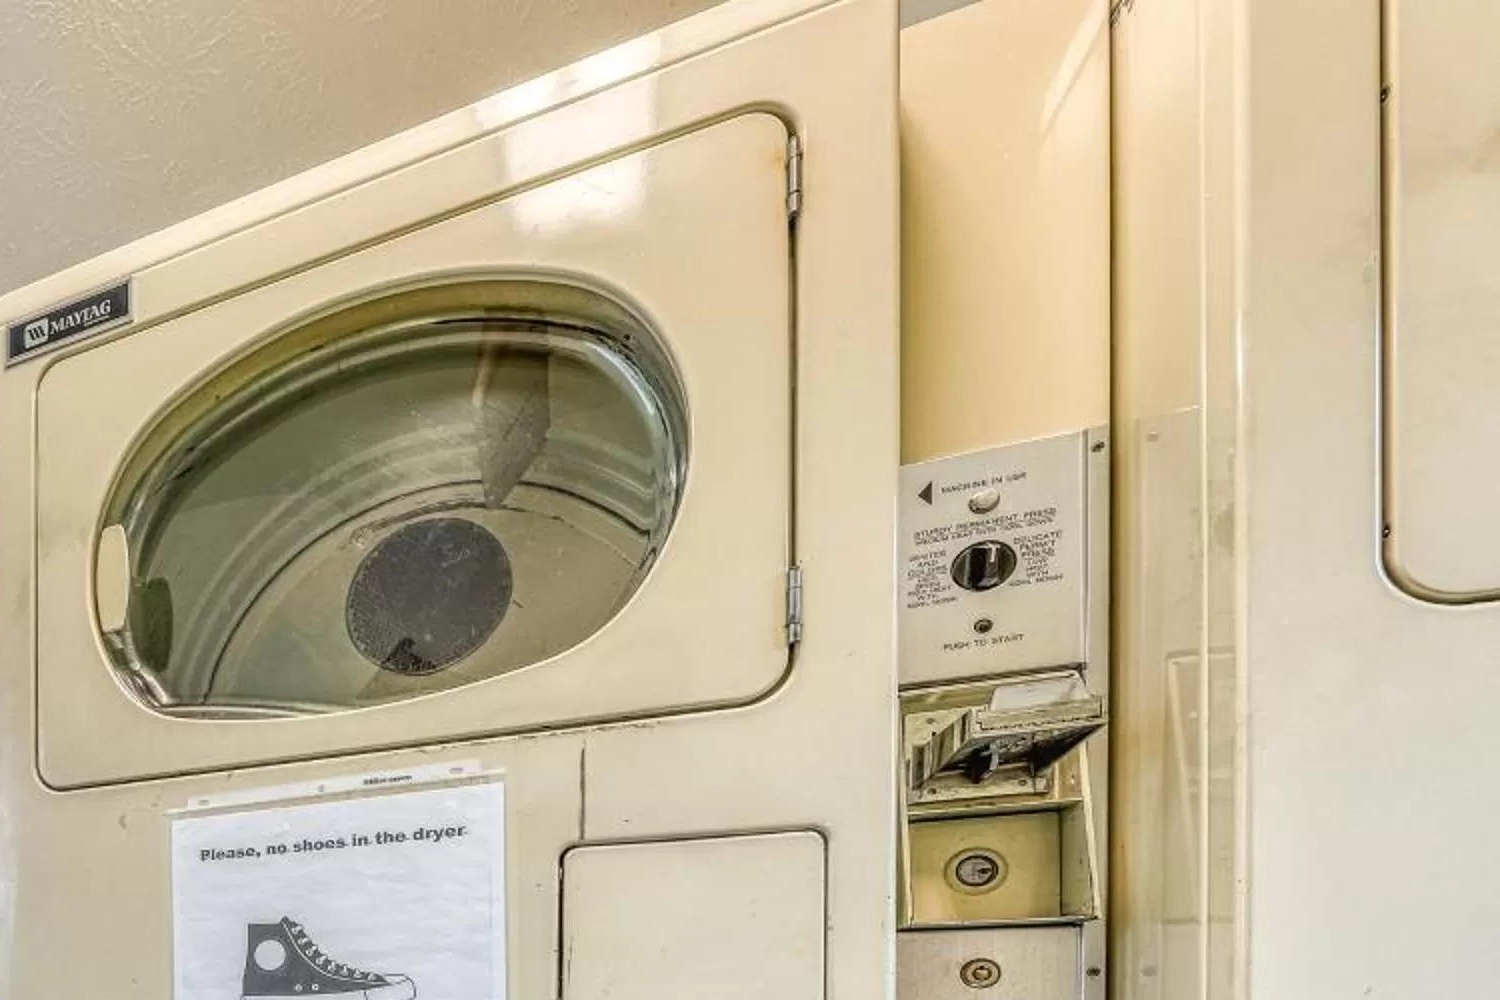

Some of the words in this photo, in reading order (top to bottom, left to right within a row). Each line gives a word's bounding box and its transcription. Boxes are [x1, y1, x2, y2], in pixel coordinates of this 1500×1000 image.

[50, 299, 112, 335] MAYTAG
[941, 479, 987, 494] MACHINE
[992, 476, 1003, 485] IN
[943, 641, 969, 651] PUSH
[974, 637, 987, 647] TO
[991, 633, 1025, 645] START
[199, 847, 262, 862] Please,
[266, 844, 288, 857] no
[294, 837, 347, 853] shoes
[352, 833, 369, 848] in
[375, 831, 408, 846] the
[413, 825, 467, 844] dryer
